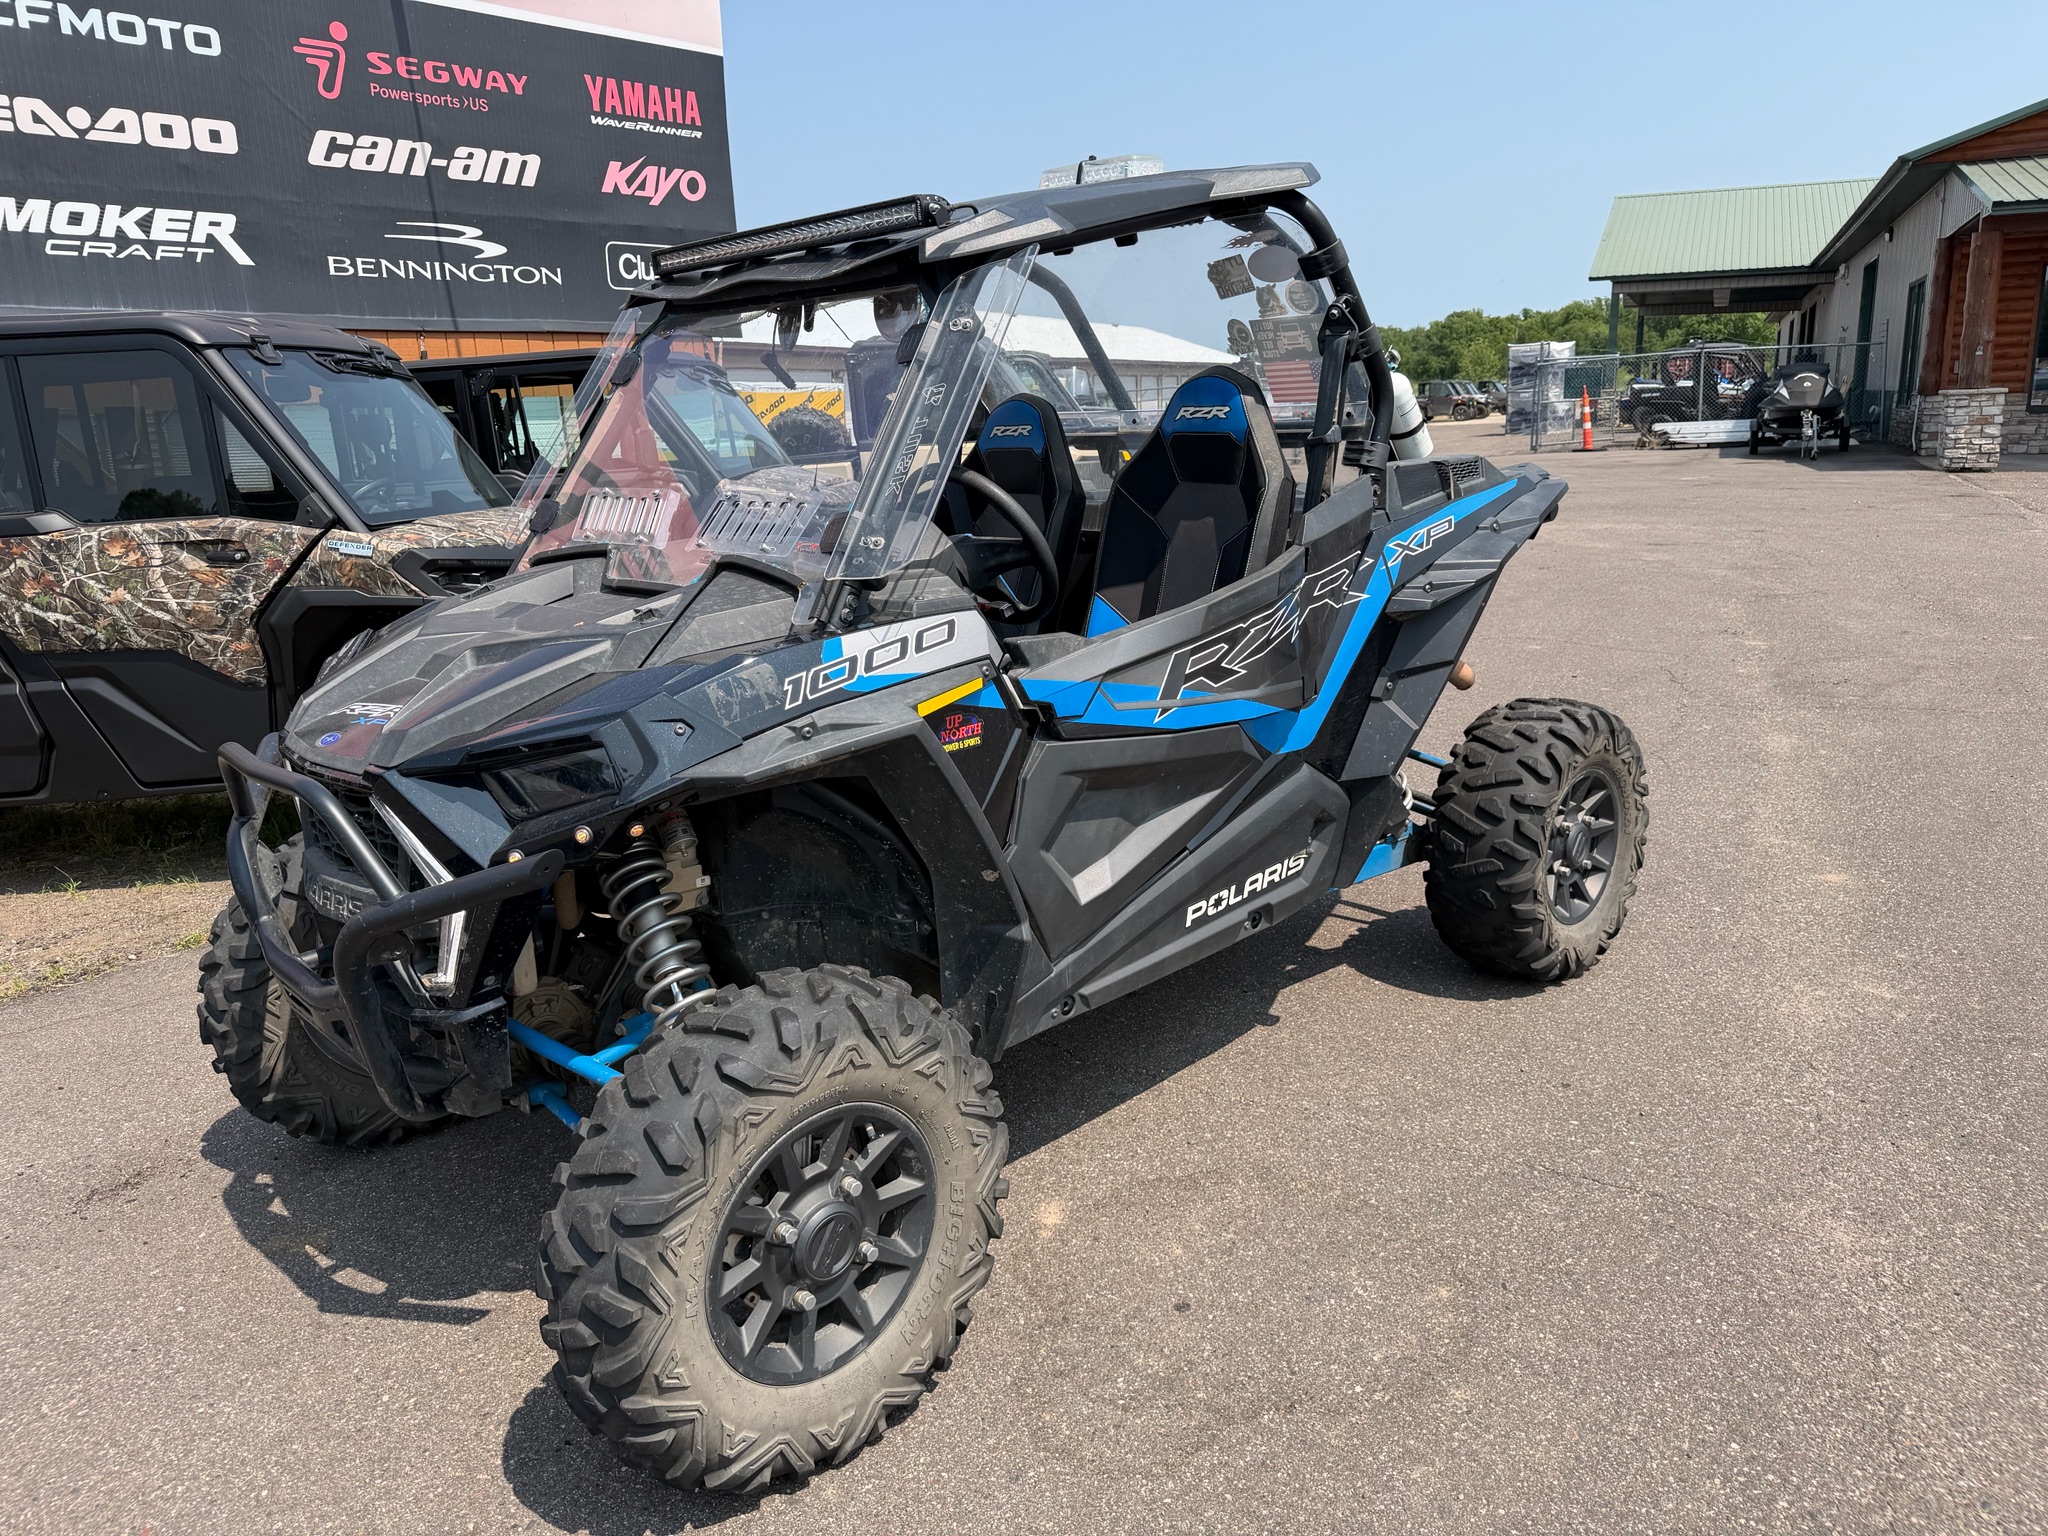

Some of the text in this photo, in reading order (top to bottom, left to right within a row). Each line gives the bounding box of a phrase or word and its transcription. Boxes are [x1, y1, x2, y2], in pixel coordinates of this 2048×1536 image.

[366, 52, 528, 95] SEGWAY
[584, 74, 702, 127] YAMAHA
[307, 129, 542, 188] can-am
[602, 155, 707, 206] KAYO
[45, 239, 215, 263] CRAFT
[326, 255, 563, 286] BENNINGTON
[989, 424, 1033, 439] RZR
[1175, 405, 1231, 421] RZR
[328, 540, 372, 551] DEFENDER
[1380, 515, 1455, 570] XP
[1153, 550, 1375, 724] RZR
[784, 615, 958, 711] 1000
[350, 717, 389, 725] XP
[941, 722, 982, 743] NORTH
[946, 714, 963, 729] UP
[964, 736, 981, 748] SPORTS
[1185, 853, 1308, 928] POLARIS
[900, 1181, 966, 1346] BIGHORN
